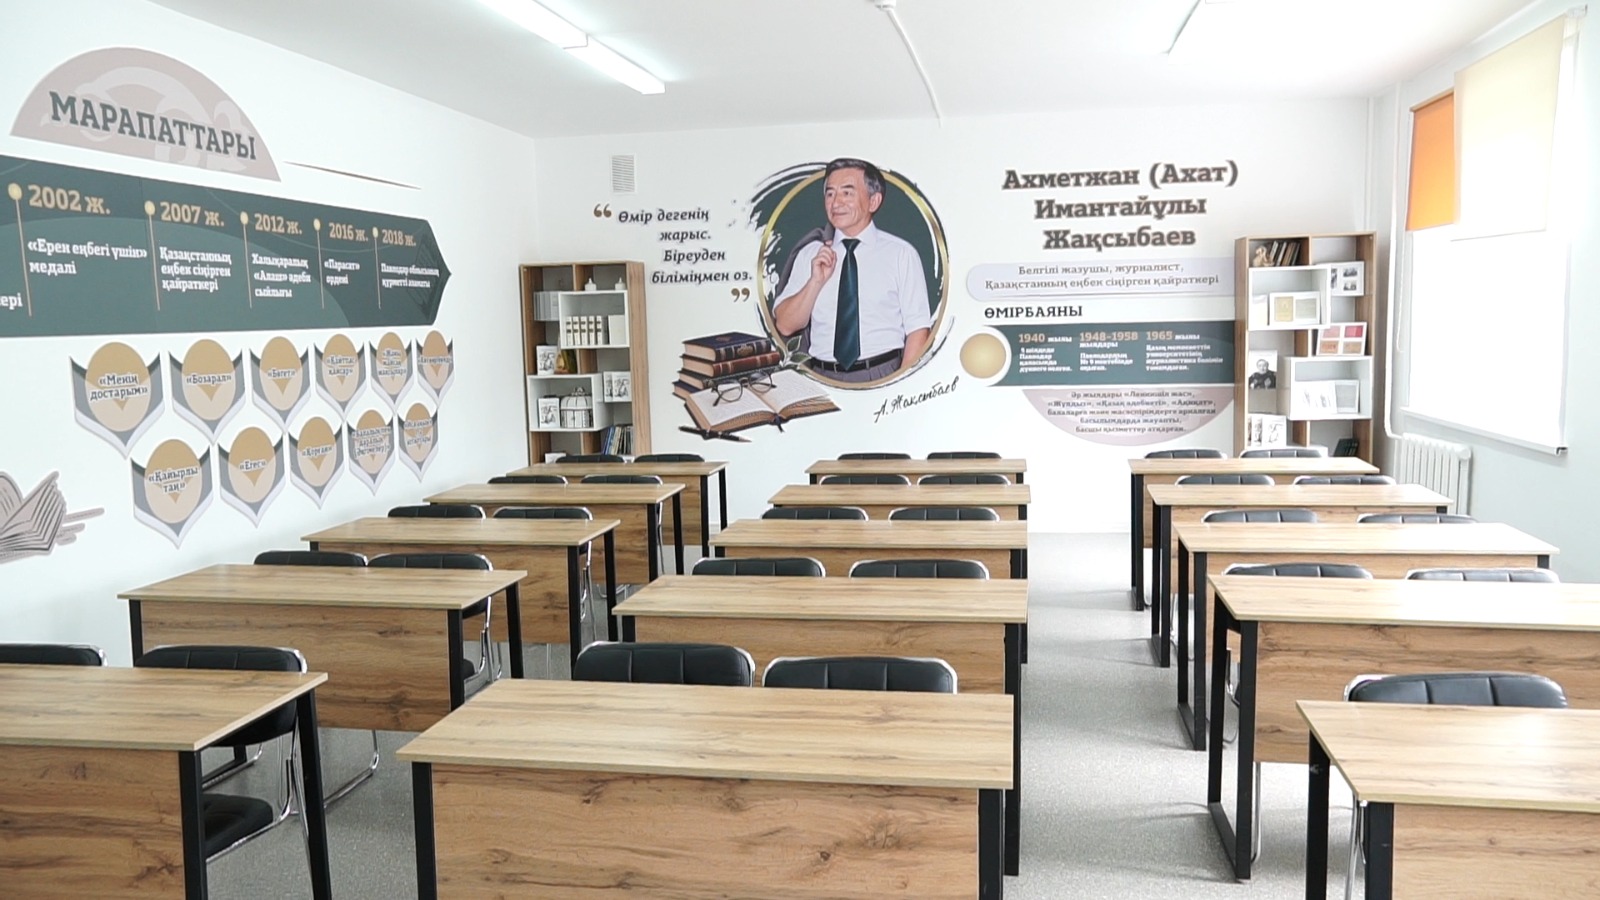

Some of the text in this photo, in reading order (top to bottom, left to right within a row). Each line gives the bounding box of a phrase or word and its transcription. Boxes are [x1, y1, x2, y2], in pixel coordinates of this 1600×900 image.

[49, 91, 257, 161] МАРАПАТТАРЫ
[1002, 160, 1239, 190] Ахметжан (Ахат)
[27, 184, 111, 214] 2002 ж.
[159, 201, 225, 227] 2007 ж.
[618, 207, 710, 224] Өмір дегенің
[1034, 196, 1208, 220] Имантайұлы
[254, 213, 303, 234] 2012 ж.
[328, 222, 369, 242] 2016 ж.
[381, 229, 417, 247] 2018 ж.
[659, 229, 712, 243] жарыс.
[1043, 226, 1197, 252] Жақсыбаев
[27, 237, 71, 256] «Ерен
[72, 241, 110, 258] еңбегі
[159, 246, 232, 265] Қазақстанның
[663, 248, 726, 264] Біреуден
[29, 261, 77, 276] медалі
[161, 262, 231, 278] еңбек сіңірген
[1018, 262, 1184, 277] Белгілі жазушы, журналист,
[162, 278, 218, 292] қайраткері
[651, 271, 753, 286] біліміңмен оз.
[985, 274, 1219, 291] Қазақстанның еңбек сіңірген қайраткері
[0, 292, 23, 310] ері
[983, 305, 1084, 319] ӨМІРБАЯНЫ
[1018, 333, 1046, 343] 1940
[1145, 331, 1173, 341] 1965
[99, 373, 139, 386] «Менің
[90, 386, 148, 401] достарым»
[162, 482, 185, 493] таң»
